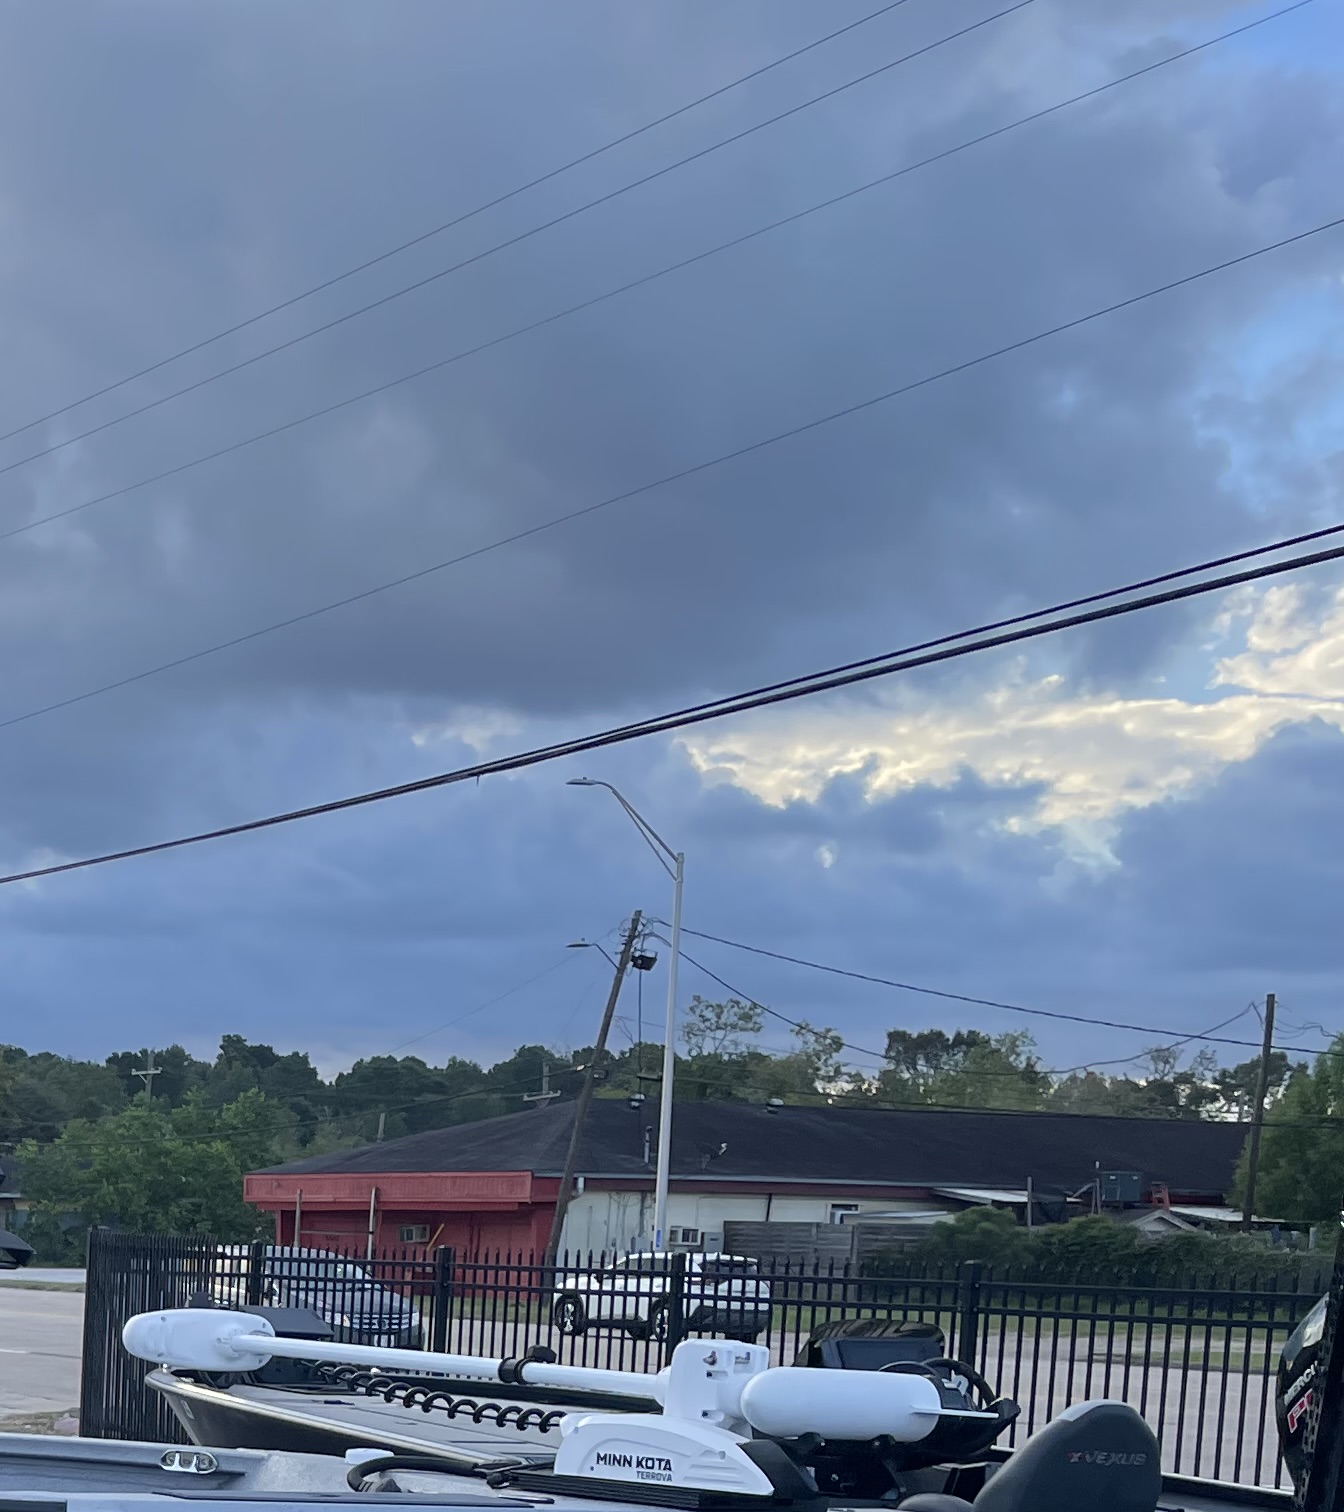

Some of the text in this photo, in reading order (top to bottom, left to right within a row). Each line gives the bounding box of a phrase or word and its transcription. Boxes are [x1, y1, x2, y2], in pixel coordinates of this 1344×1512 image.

[596, 1451, 673, 1472] MINN KOTA
[636, 1470, 673, 1482] TERROVA
